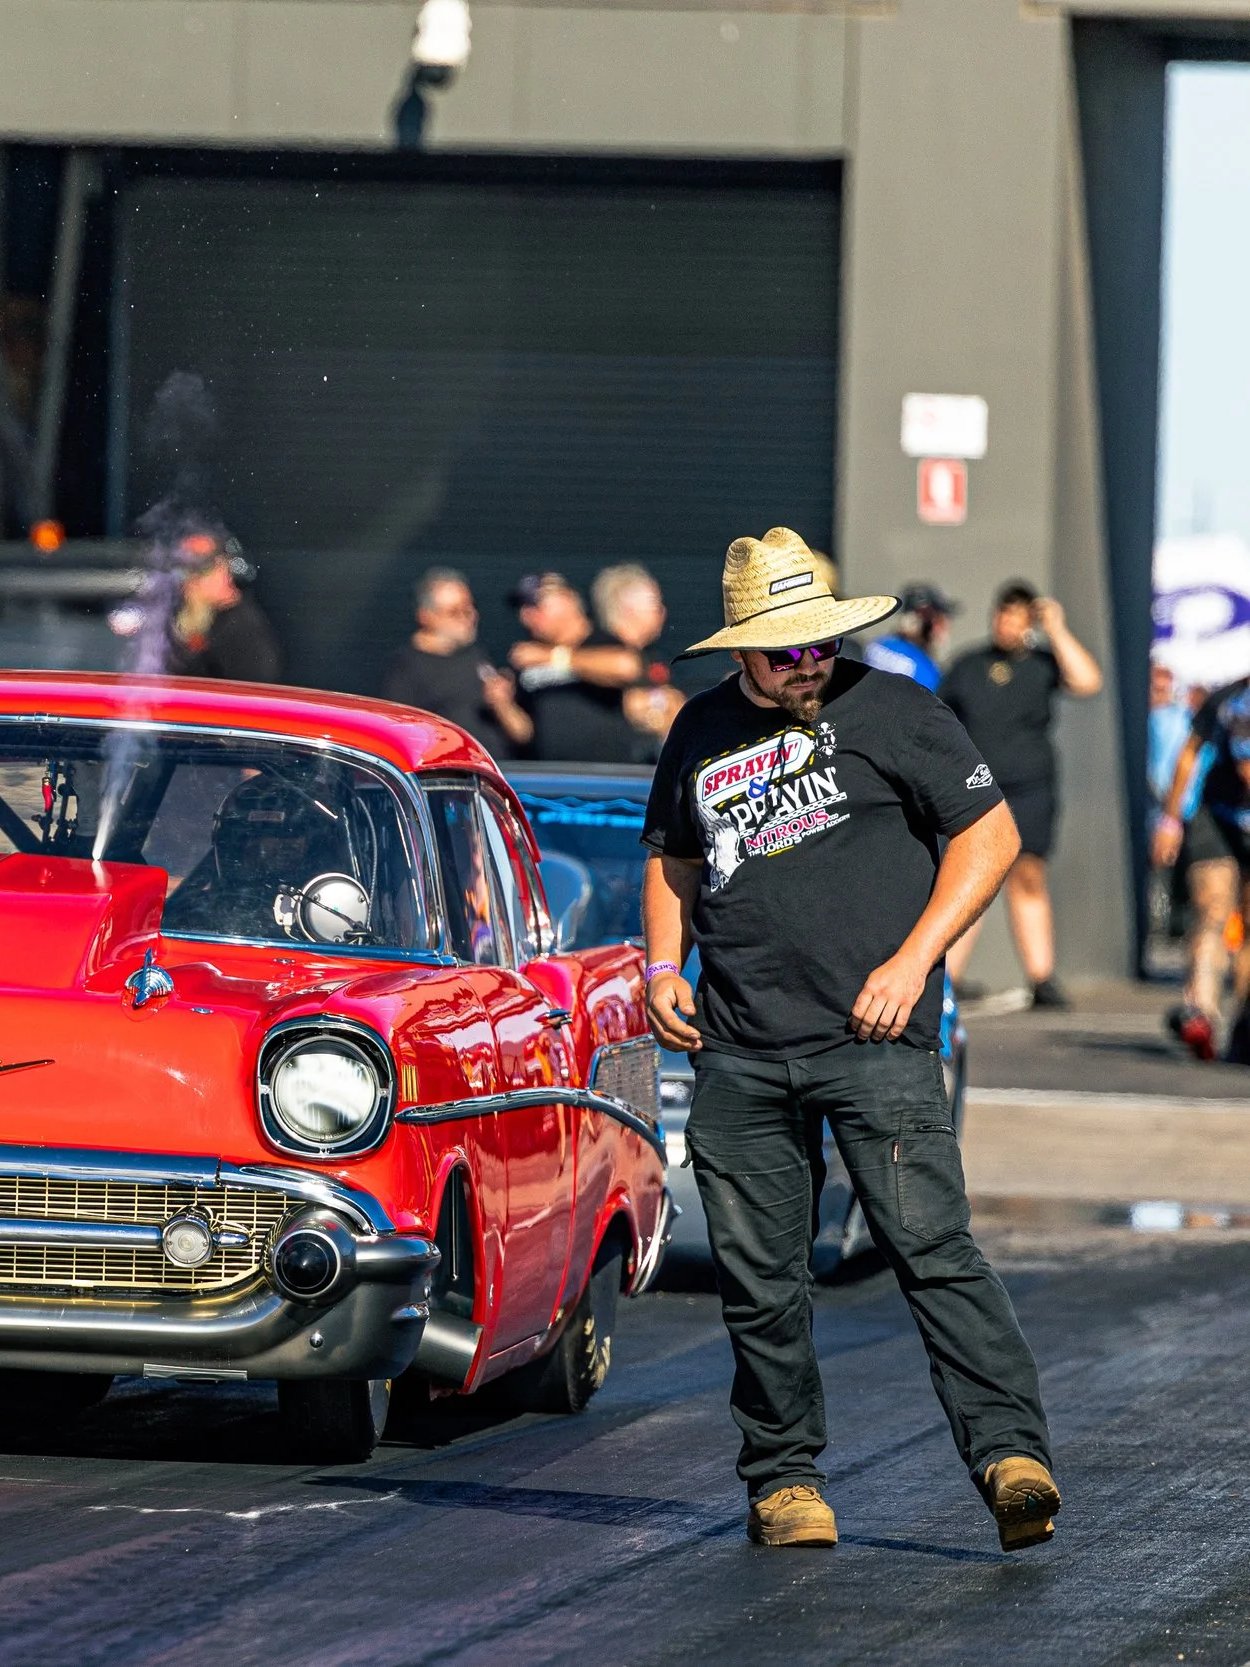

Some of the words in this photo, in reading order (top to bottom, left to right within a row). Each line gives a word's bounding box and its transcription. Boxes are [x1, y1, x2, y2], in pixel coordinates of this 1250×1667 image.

[704, 742, 799, 797] SPRAYIN'
[748, 776, 771, 799] &
[730, 766, 840, 832] PRAYIN'
[761, 834, 803, 856] LORD'S
